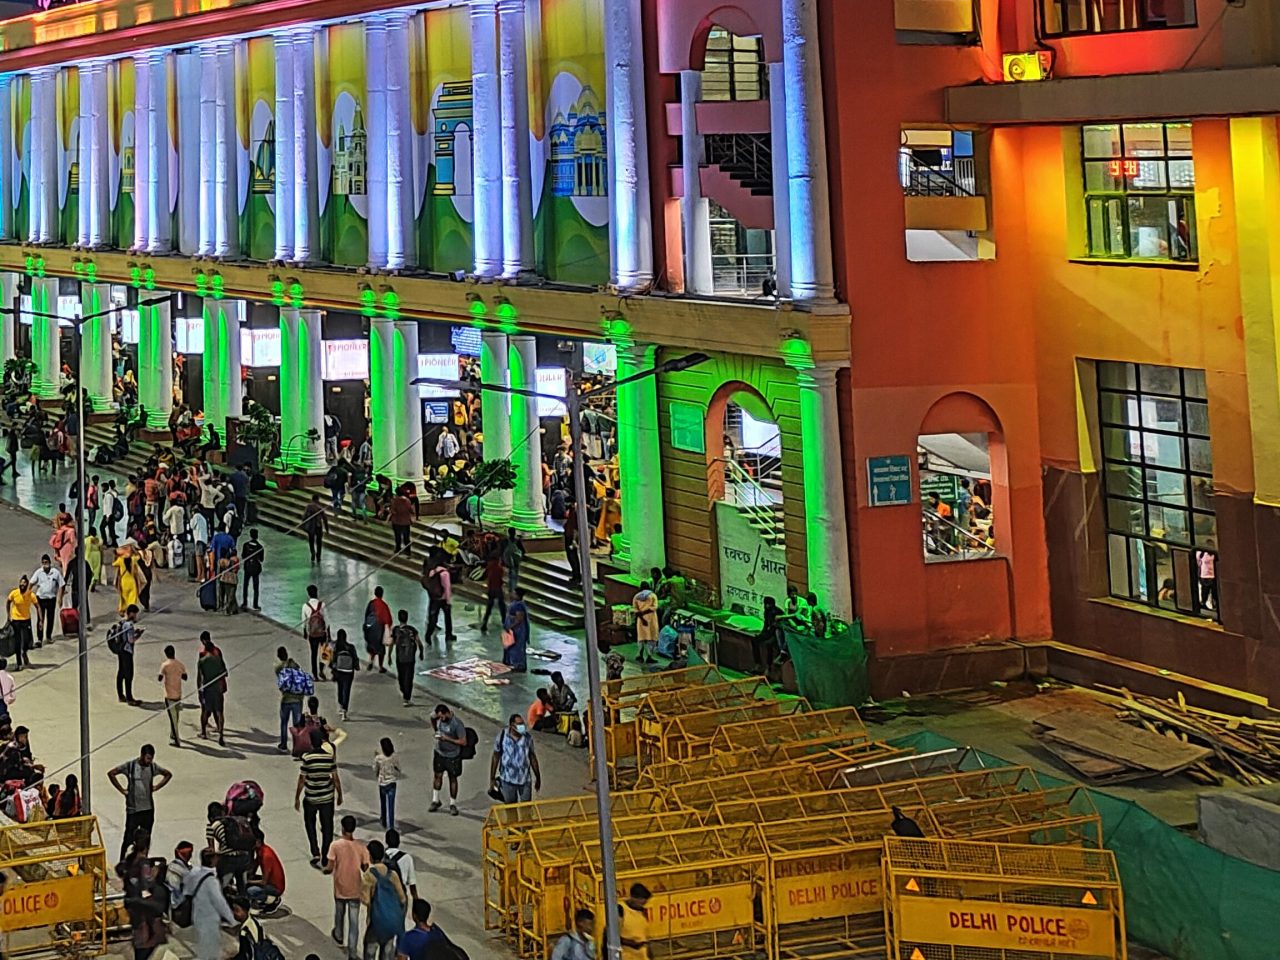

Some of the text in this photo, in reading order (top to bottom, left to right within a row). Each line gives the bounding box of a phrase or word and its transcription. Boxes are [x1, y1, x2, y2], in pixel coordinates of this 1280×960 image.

[723, 545, 787, 576] स्वच्छ भारत
[3, 894, 42, 916] OLICE
[789, 879, 878, 906] DELHI POLICE
[658, 899, 706, 922] POLICE
[949, 911, 1067, 937] DELHI POLICE
